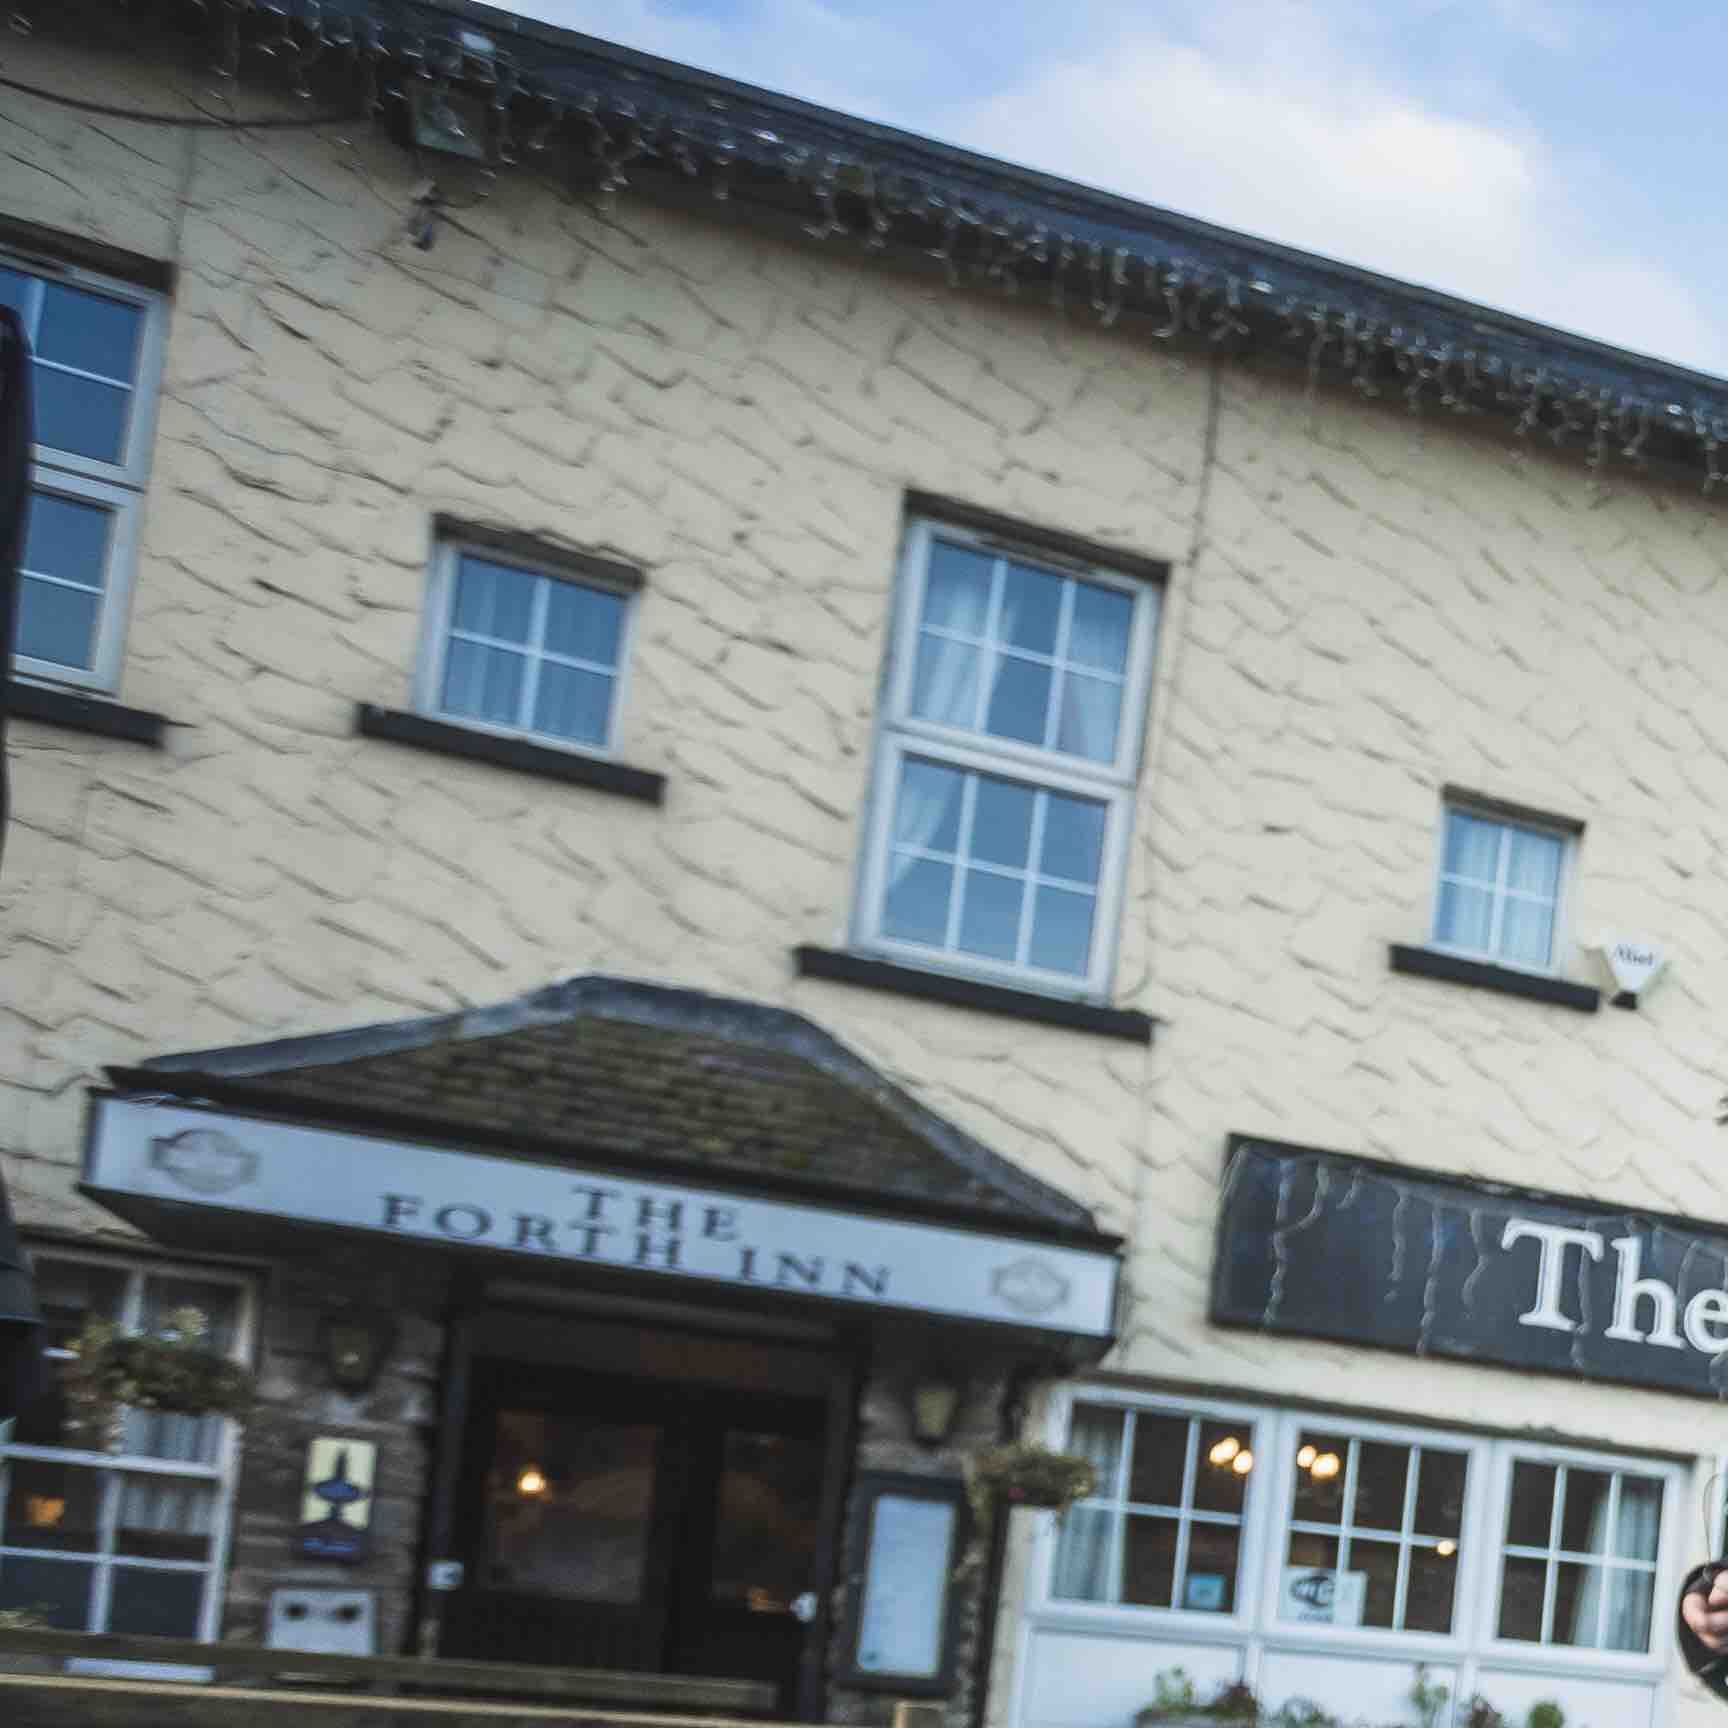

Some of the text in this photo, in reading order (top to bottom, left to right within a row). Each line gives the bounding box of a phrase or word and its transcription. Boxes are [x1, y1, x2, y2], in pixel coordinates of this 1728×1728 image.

[380, 1192, 893, 1299] FORTH INN
[572, 1184, 742, 1244] THE
